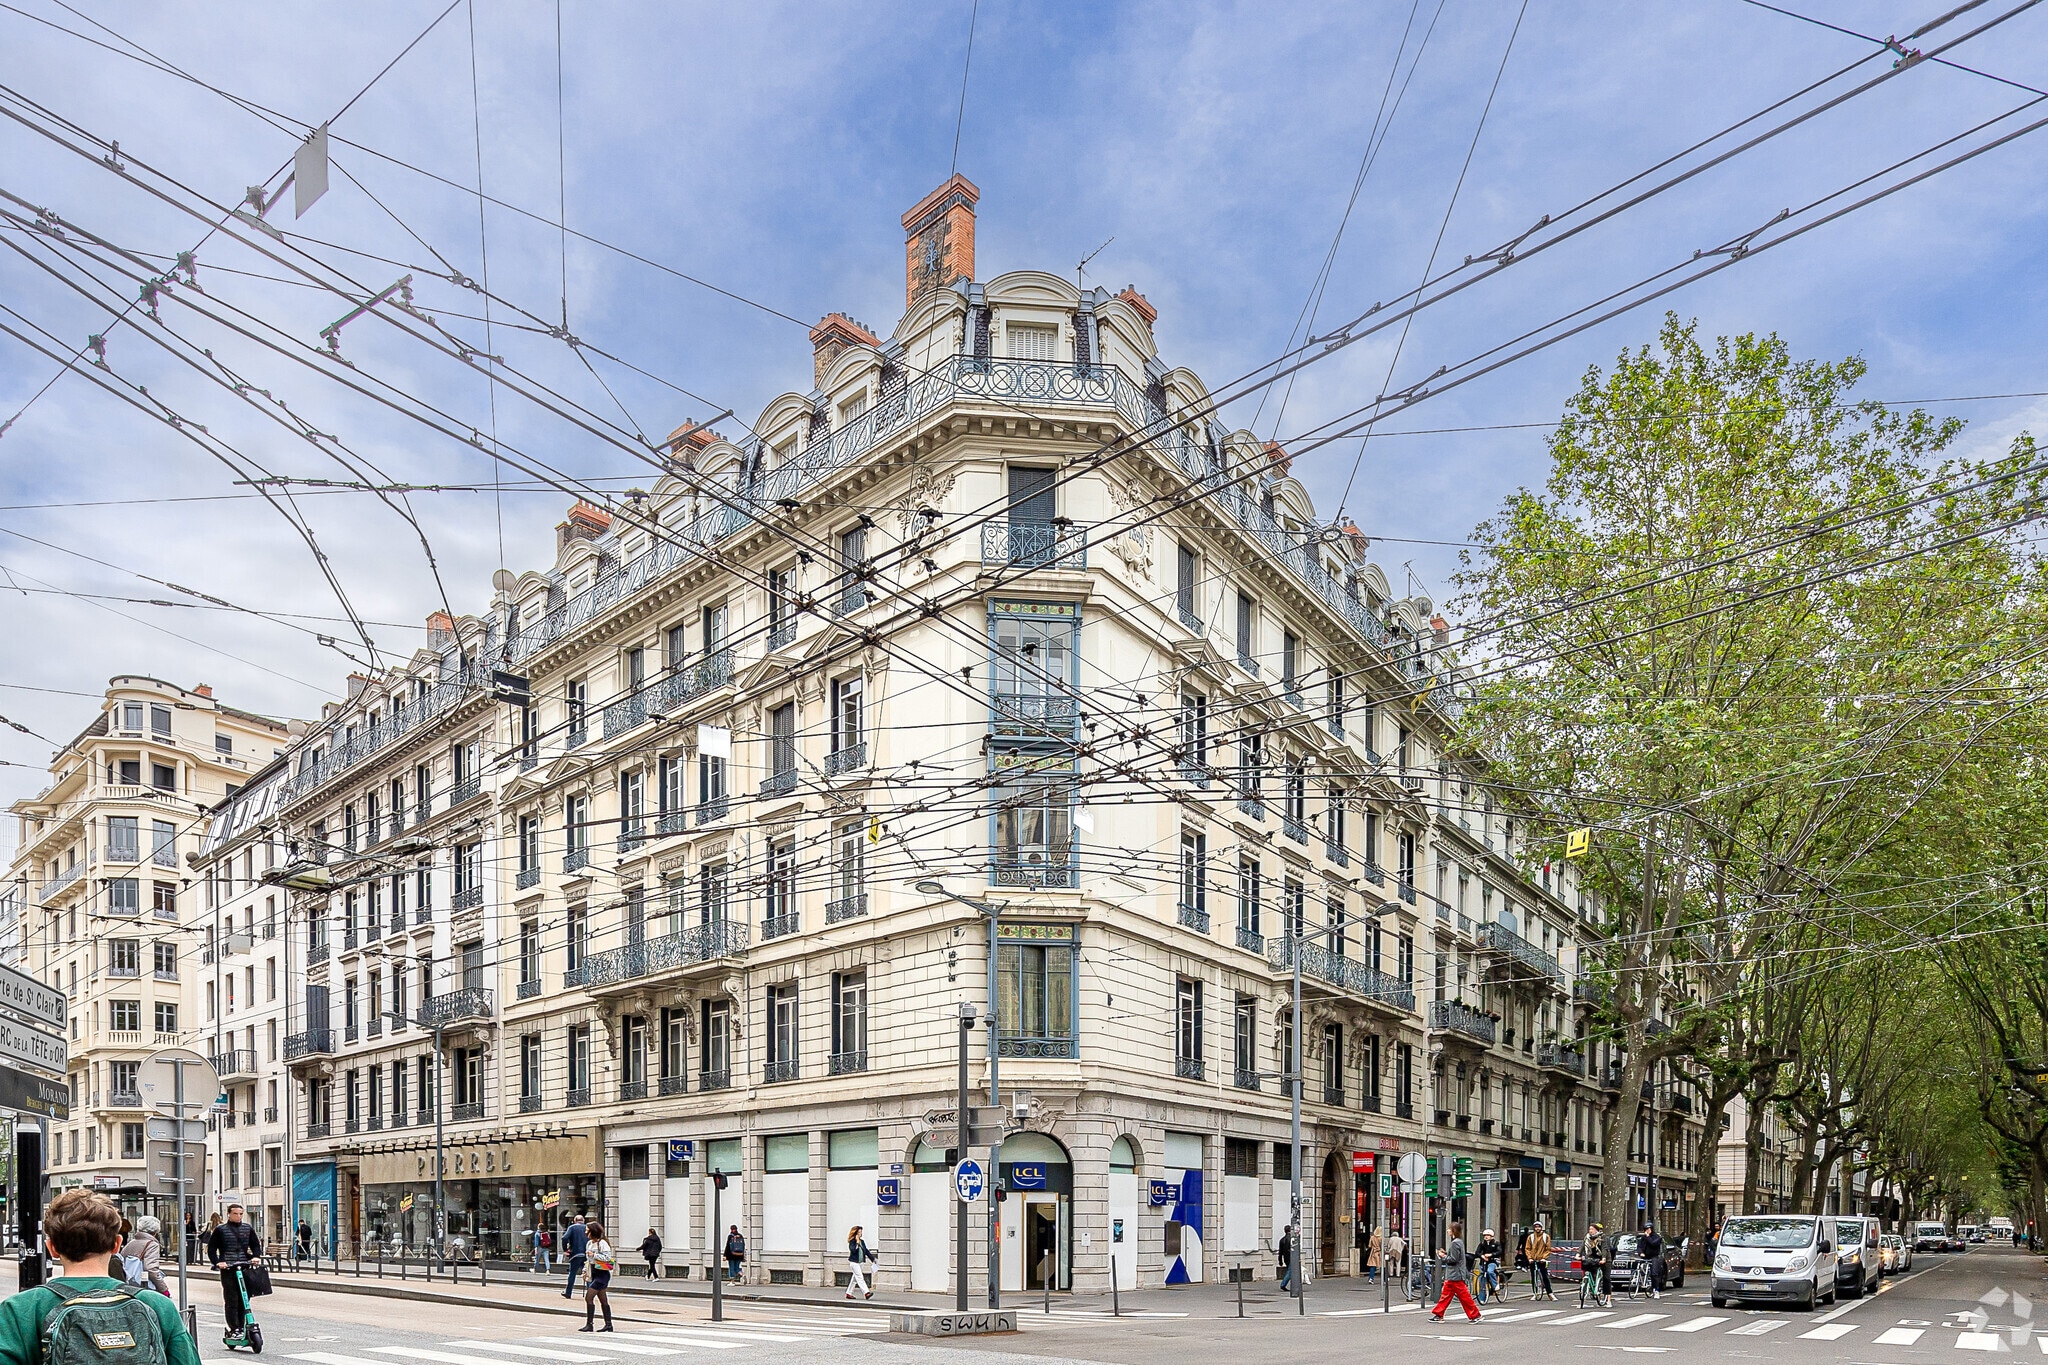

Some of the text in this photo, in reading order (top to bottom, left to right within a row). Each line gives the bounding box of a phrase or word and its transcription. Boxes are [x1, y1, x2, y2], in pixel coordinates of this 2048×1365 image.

[0, 978, 55, 1016] te de St Clair
[31, 1034, 48, 1061] TÊTE
[38, 1082, 67, 1105] MORAND
[671, 1144, 690, 1152] LCL
[417, 1150, 512, 1176] PIERREL
[1015, 1167, 1043, 1177] LCL
[878, 1185, 896, 1194] LCL
[1151, 1186, 1166, 1195] LCL
[1383, 1178, 1389, 1193] P
